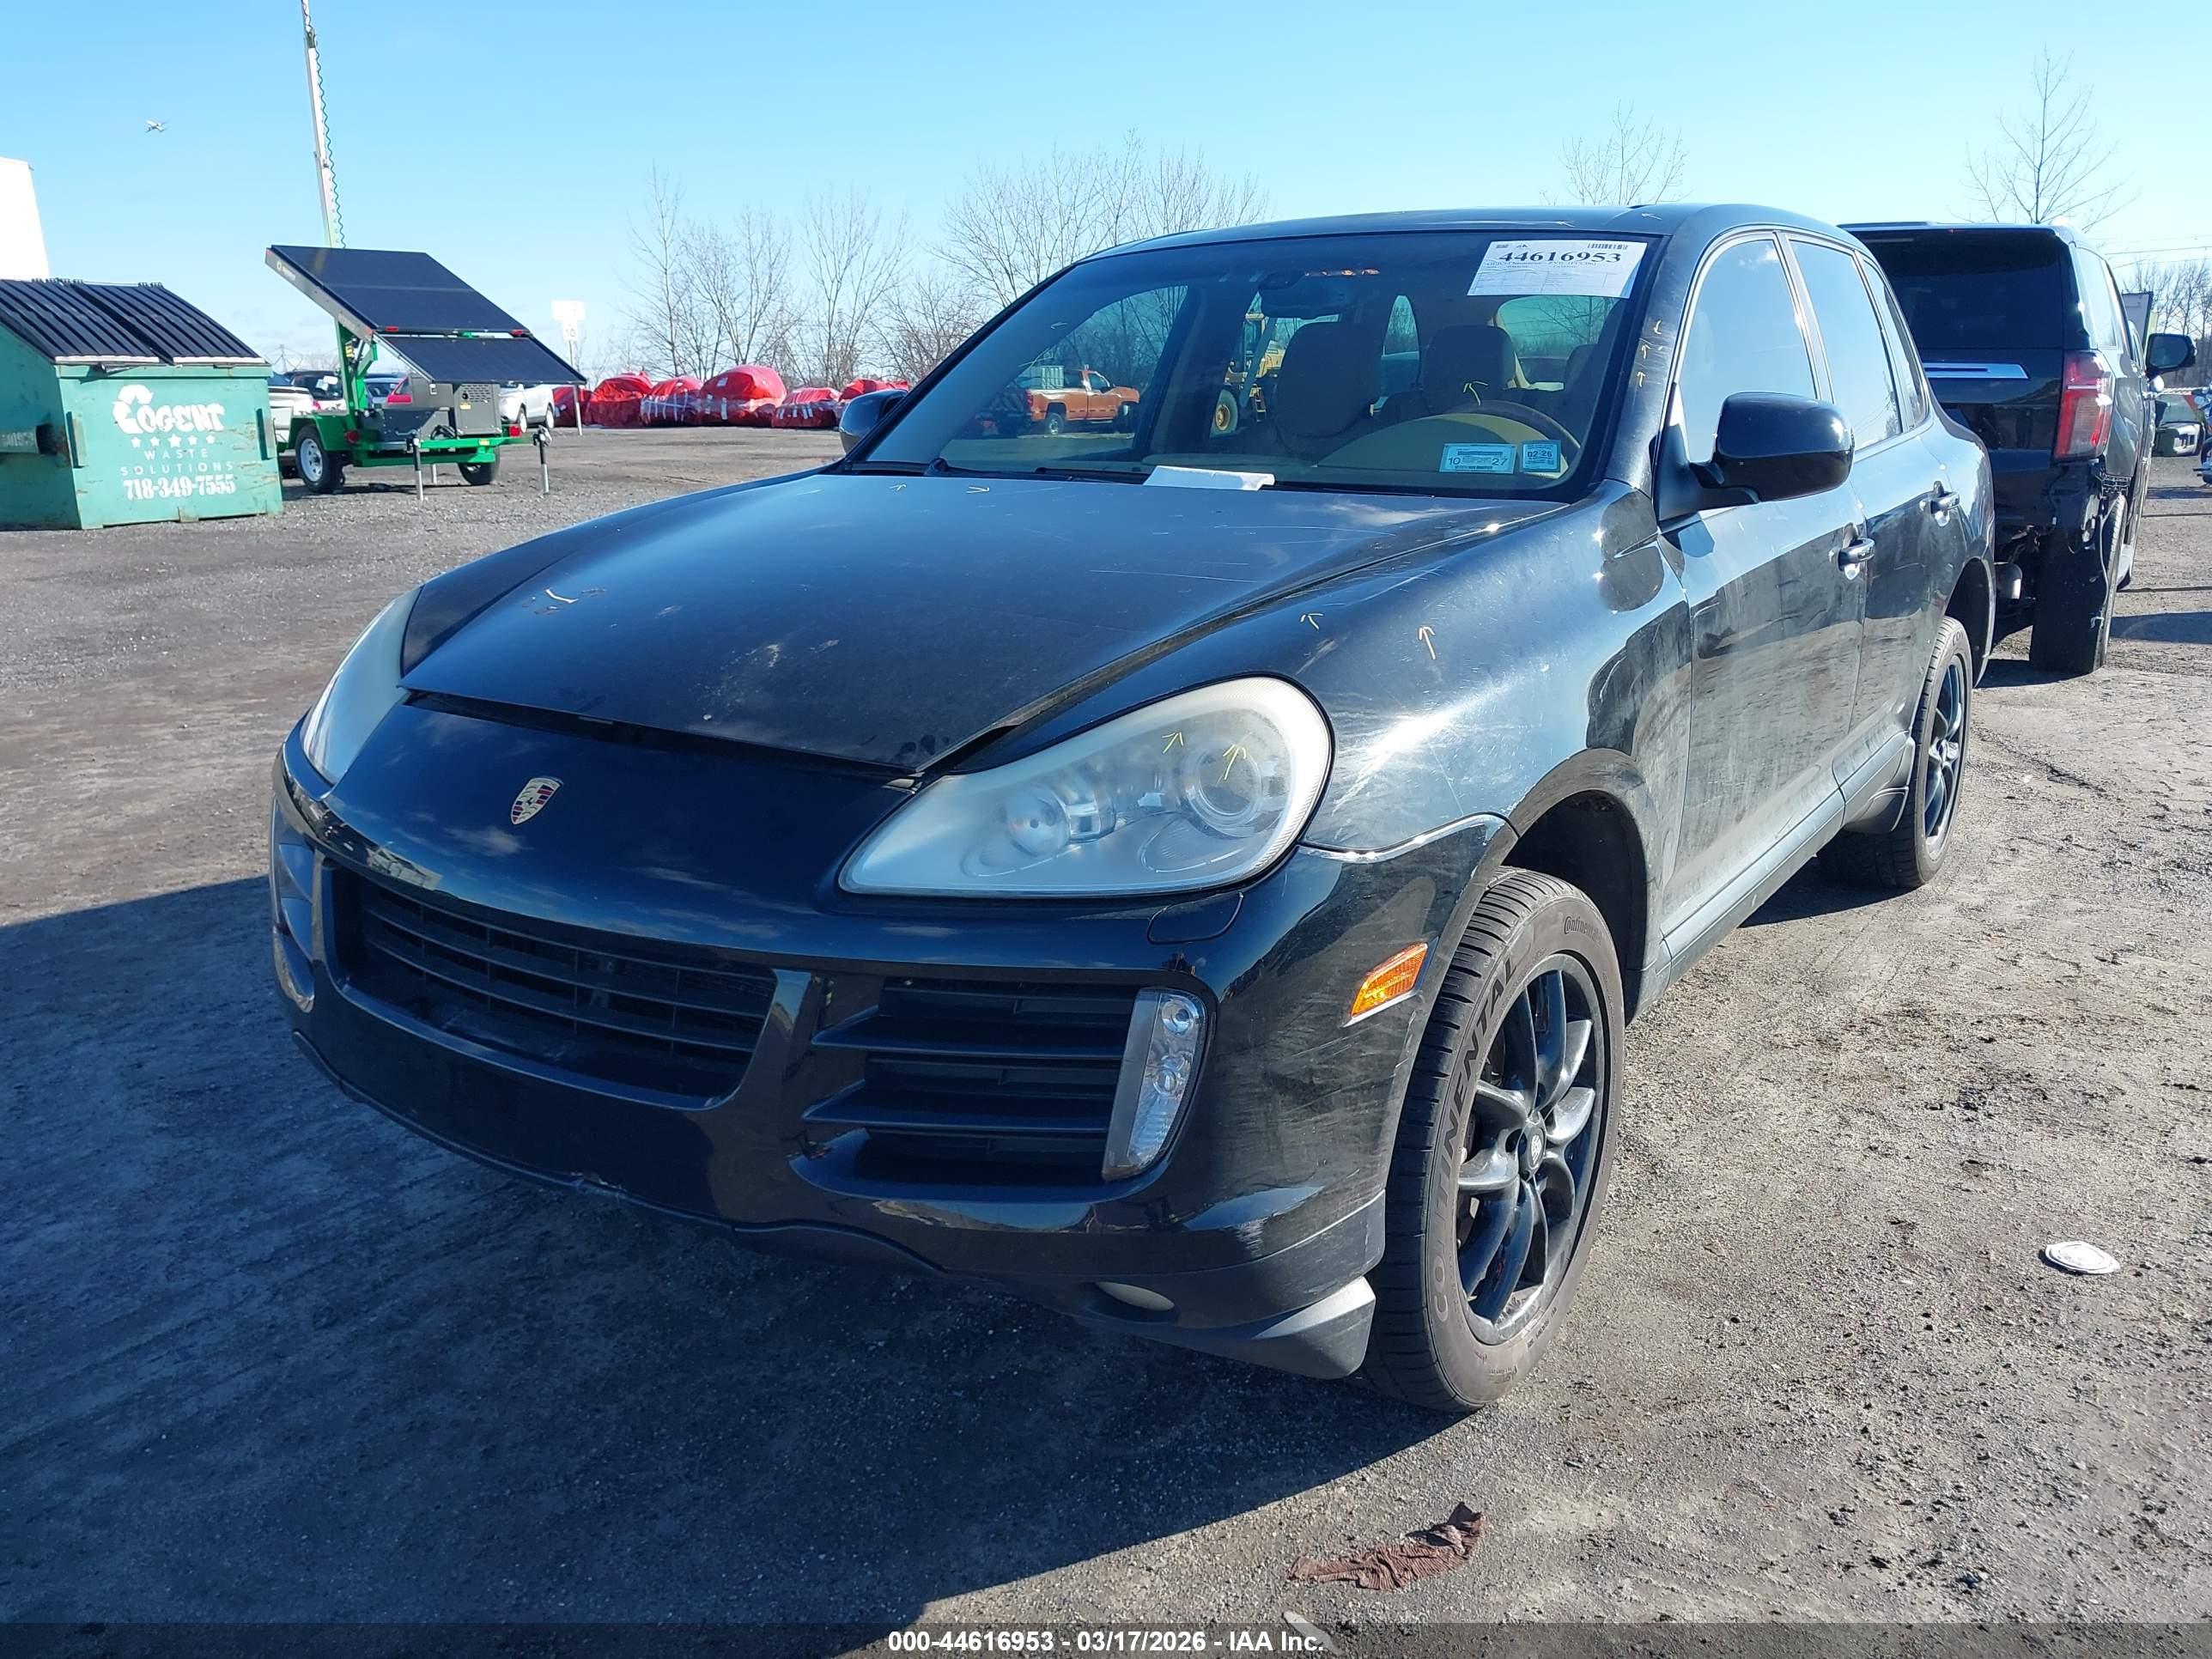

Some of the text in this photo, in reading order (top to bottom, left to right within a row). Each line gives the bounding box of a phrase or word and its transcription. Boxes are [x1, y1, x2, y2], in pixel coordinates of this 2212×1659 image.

[1498, 251, 1622, 264] 44616953
[143, 448, 209, 461] WASTE
[1448, 457, 1461, 465] 10
[1492, 457, 1508, 465] 27
[120, 461, 234, 477] SOLUTIONS
[123, 473, 237, 501] 718-349-7555
